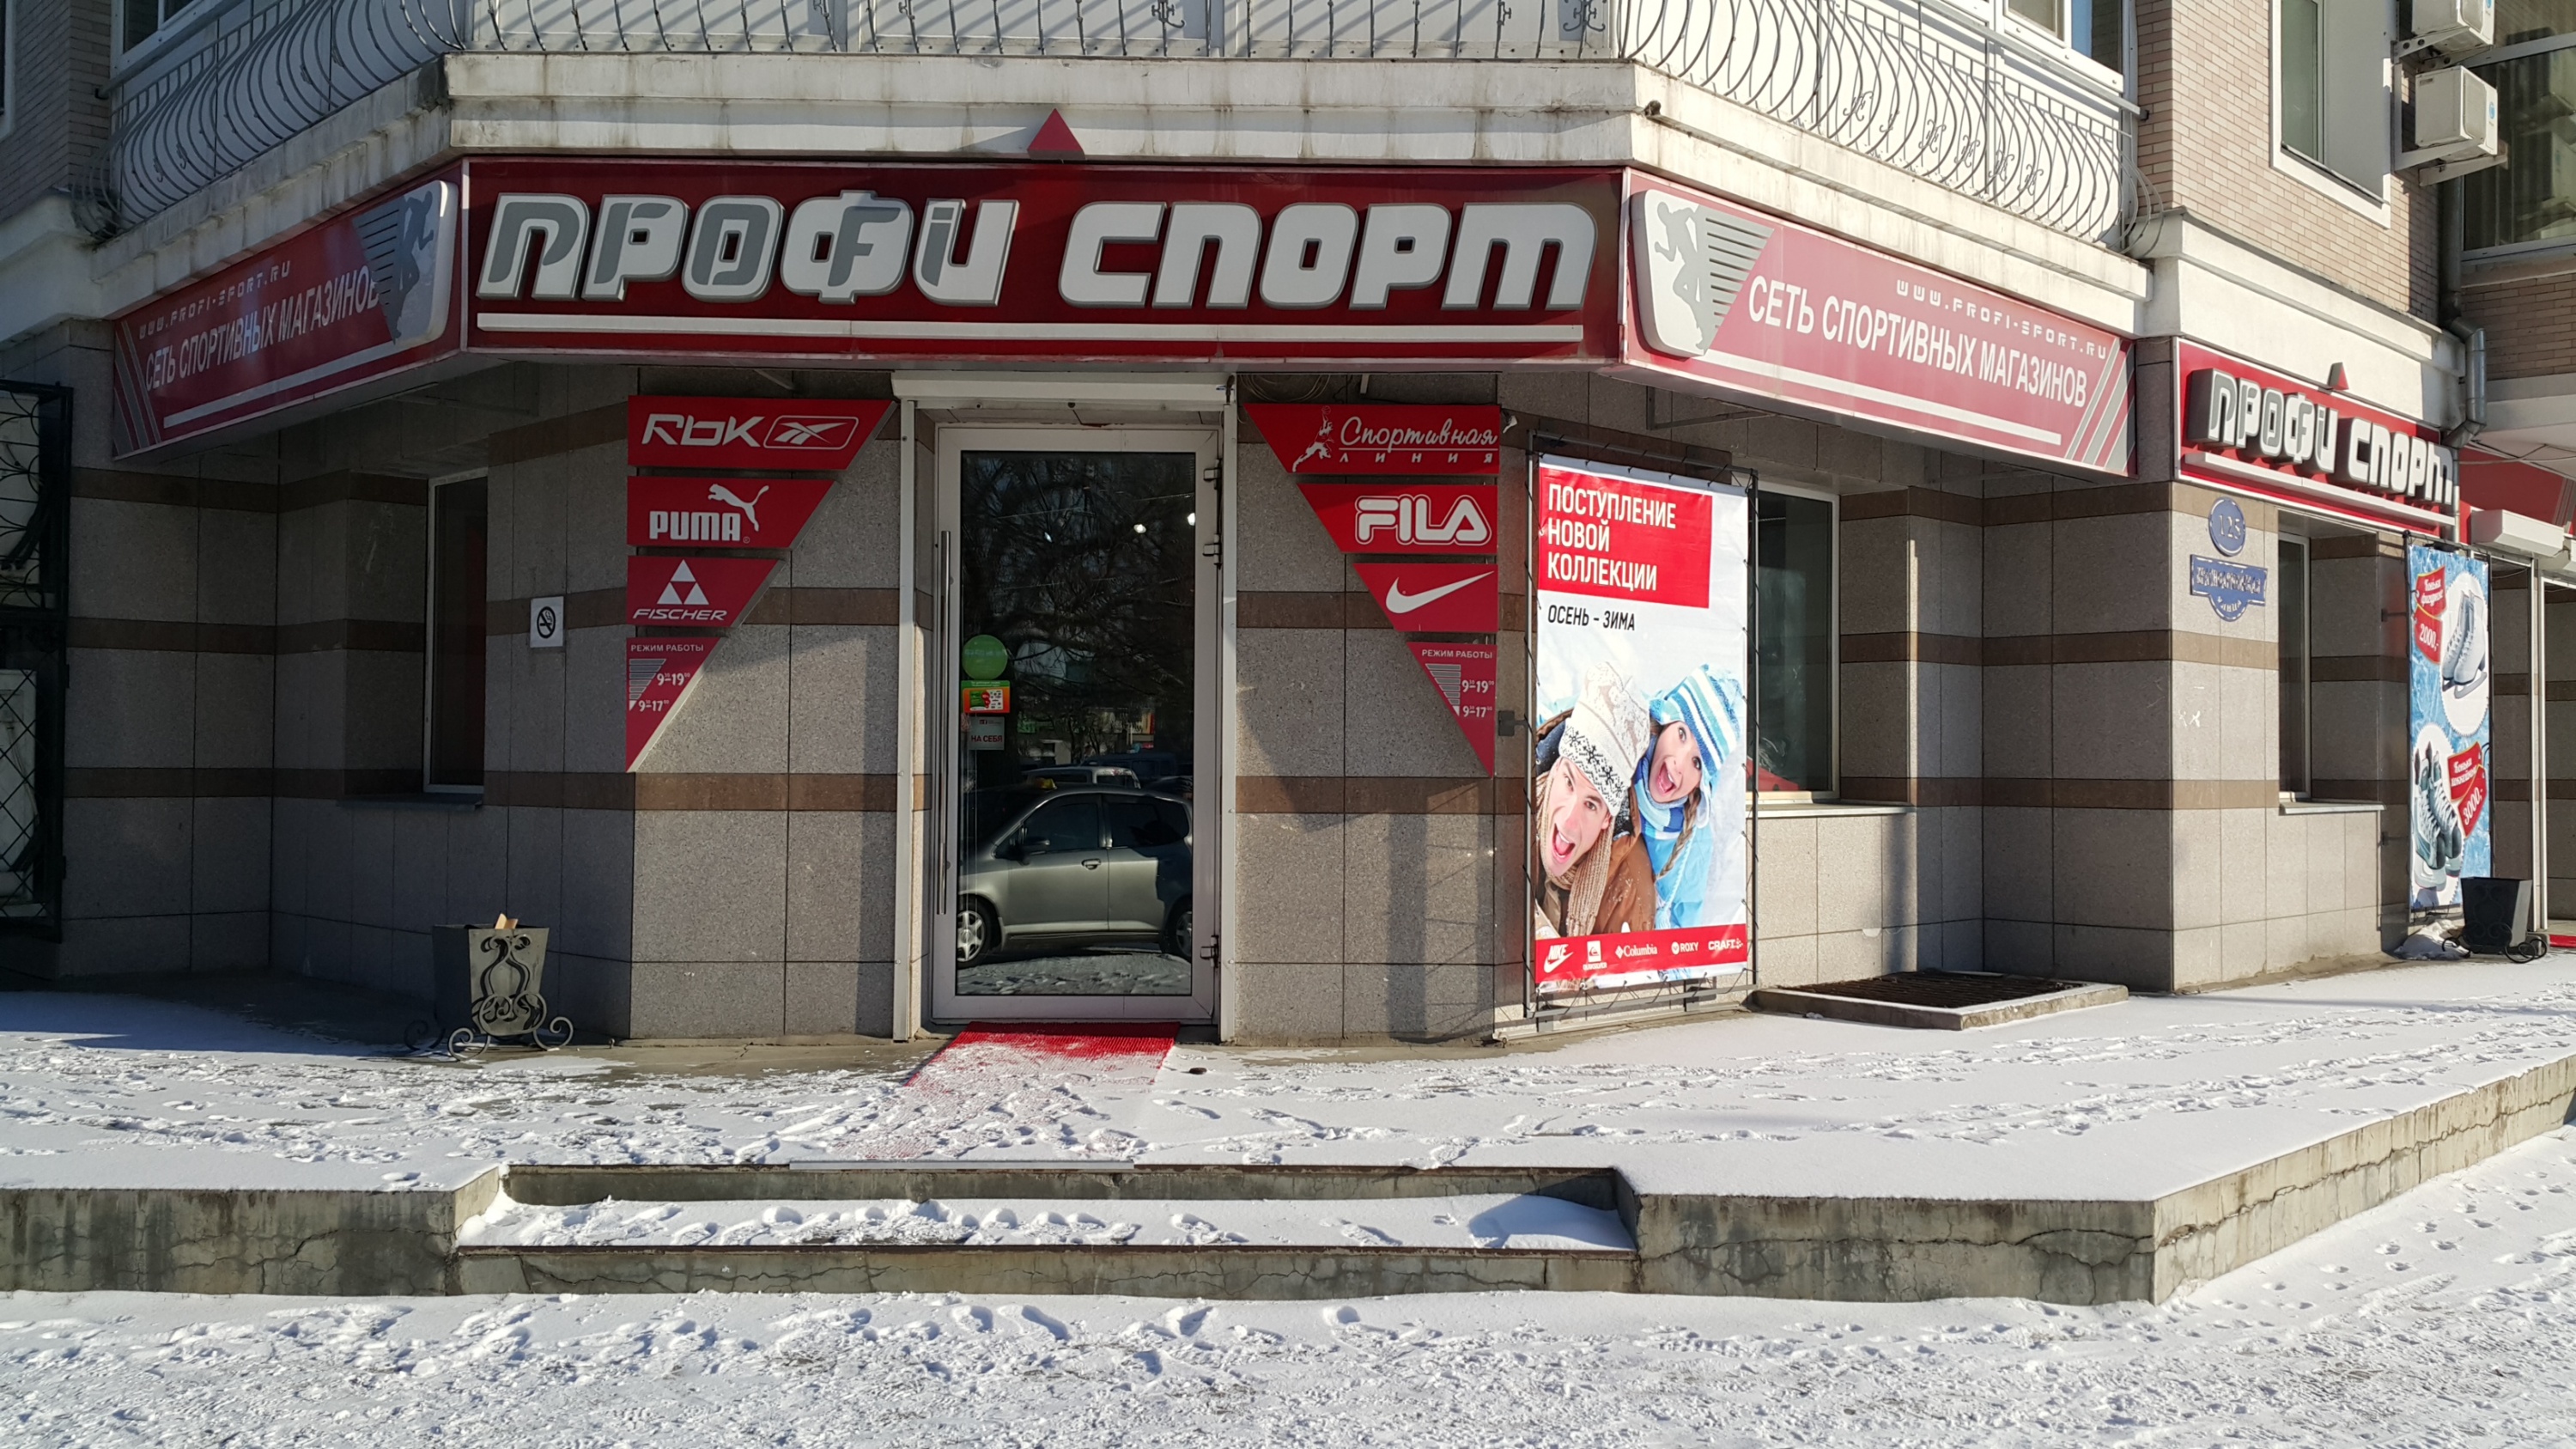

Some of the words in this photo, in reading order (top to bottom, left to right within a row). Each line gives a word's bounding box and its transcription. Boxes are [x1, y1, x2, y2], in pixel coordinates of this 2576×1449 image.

[1058, 201, 1598, 310] СПОРТ
[145, 344, 176, 392] СЕТЬ
[179, 304, 275, 379] СПОРТИВНЫХ
[277, 265, 380, 344] МАГАЗИНОВ
[1747, 275, 1815, 334] СЕТЬ
[1821, 295, 1975, 378] СПОРТИВНЫХ
[1978, 339, 2088, 409] МАГАЗИНОВ
[1340, 416, 1498, 454] Спортивная
[2345, 416, 2454, 506] СПОРТ
[1357, 495, 1491, 545] FILA
[1548, 483, 1677, 529] ПОСТУПЛЕНИЕ
[649, 510, 741, 541] PUMA
[1547, 517, 1611, 552] НОВОЙ
[2219, 514, 2242, 540] 125
[1547, 551, 1657, 592] КОЛЛЕКЦИИ
[632, 608, 728, 621] FISCHER
[1547, 605, 1589, 627] ОСЕНЬ
[1603, 610, 1636, 631] ЗИМА
[665, 644, 704, 653] РАБОТЫ
[1421, 649, 1454, 658] РЕЖИМ
[1455, 650, 1493, 659] РАБОТЫ
[1623, 943, 1658, 958] Columbia
[1680, 942, 1699, 953] ROXY
